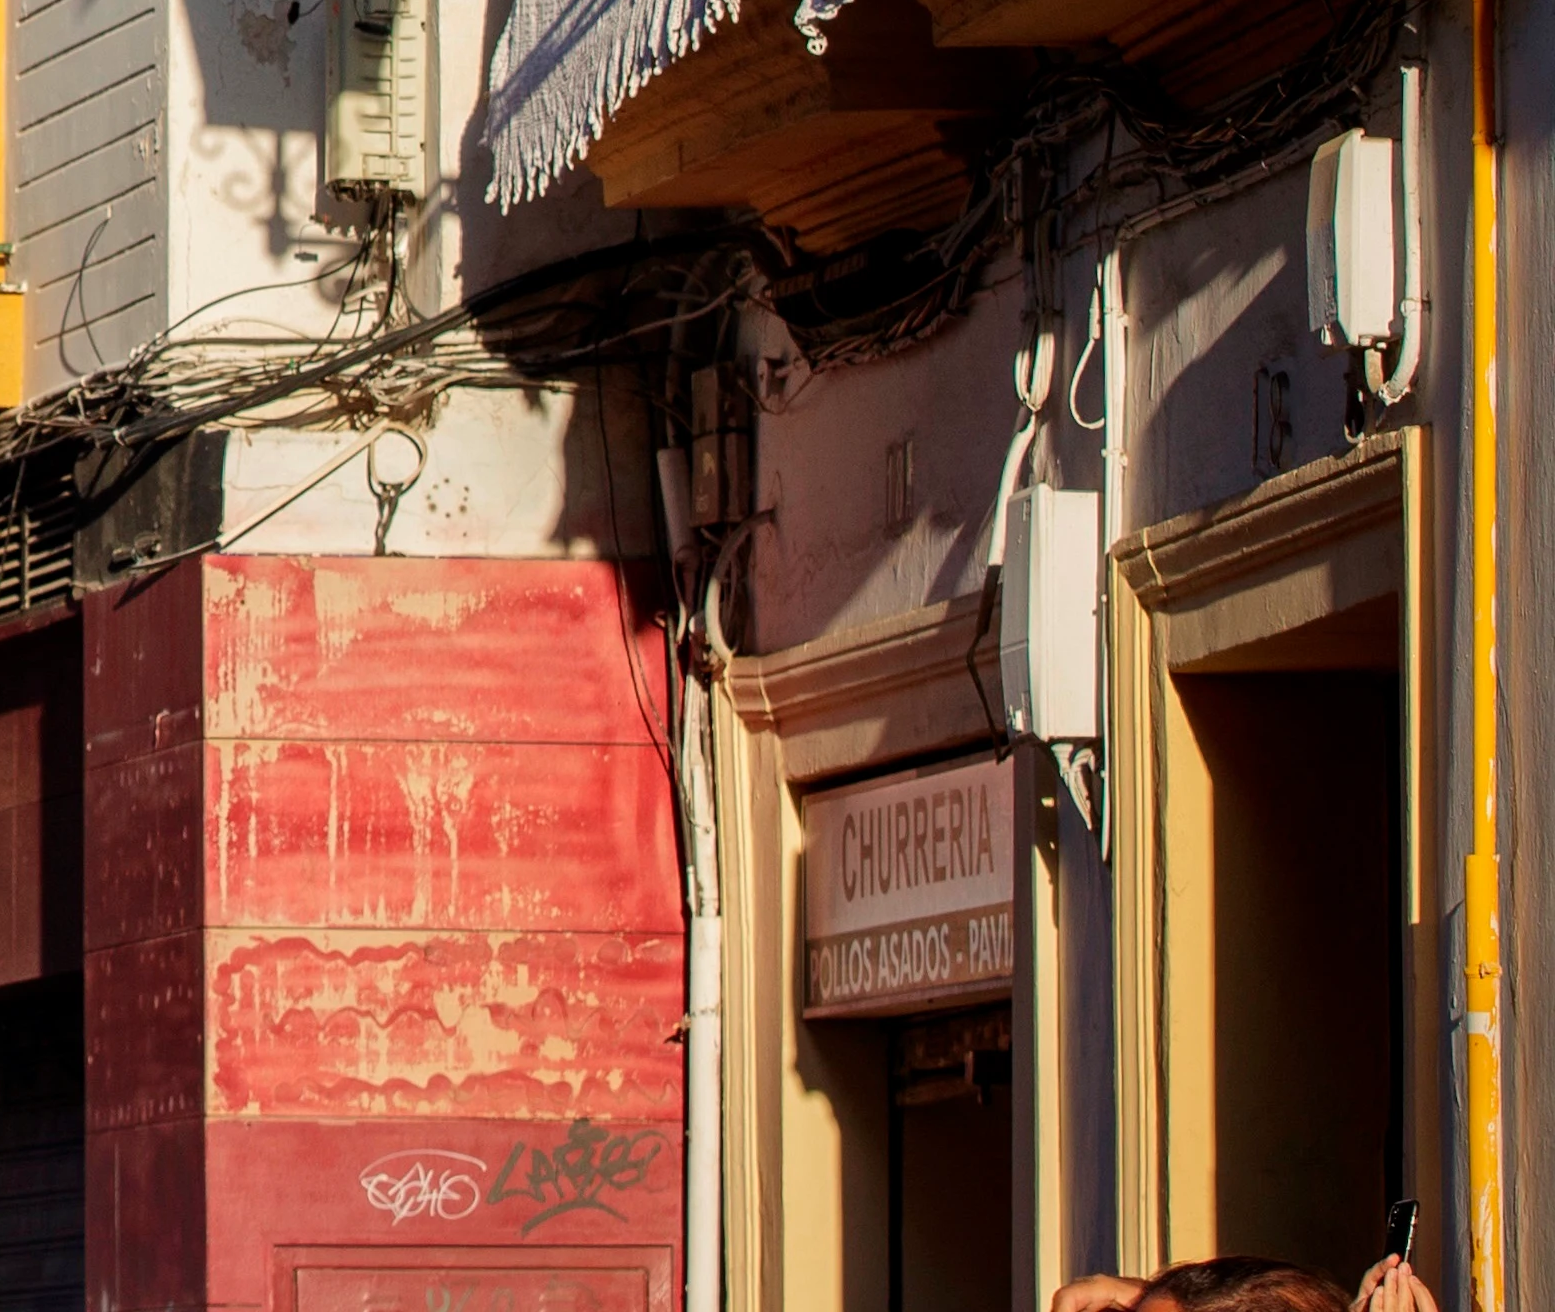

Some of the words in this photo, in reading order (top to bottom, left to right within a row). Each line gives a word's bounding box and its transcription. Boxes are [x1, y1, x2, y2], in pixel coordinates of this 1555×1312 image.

[841, 783, 995, 903] CHURRERIA
[810, 936, 873, 1002] POLLOS
[877, 922, 951, 989] ASADOS
